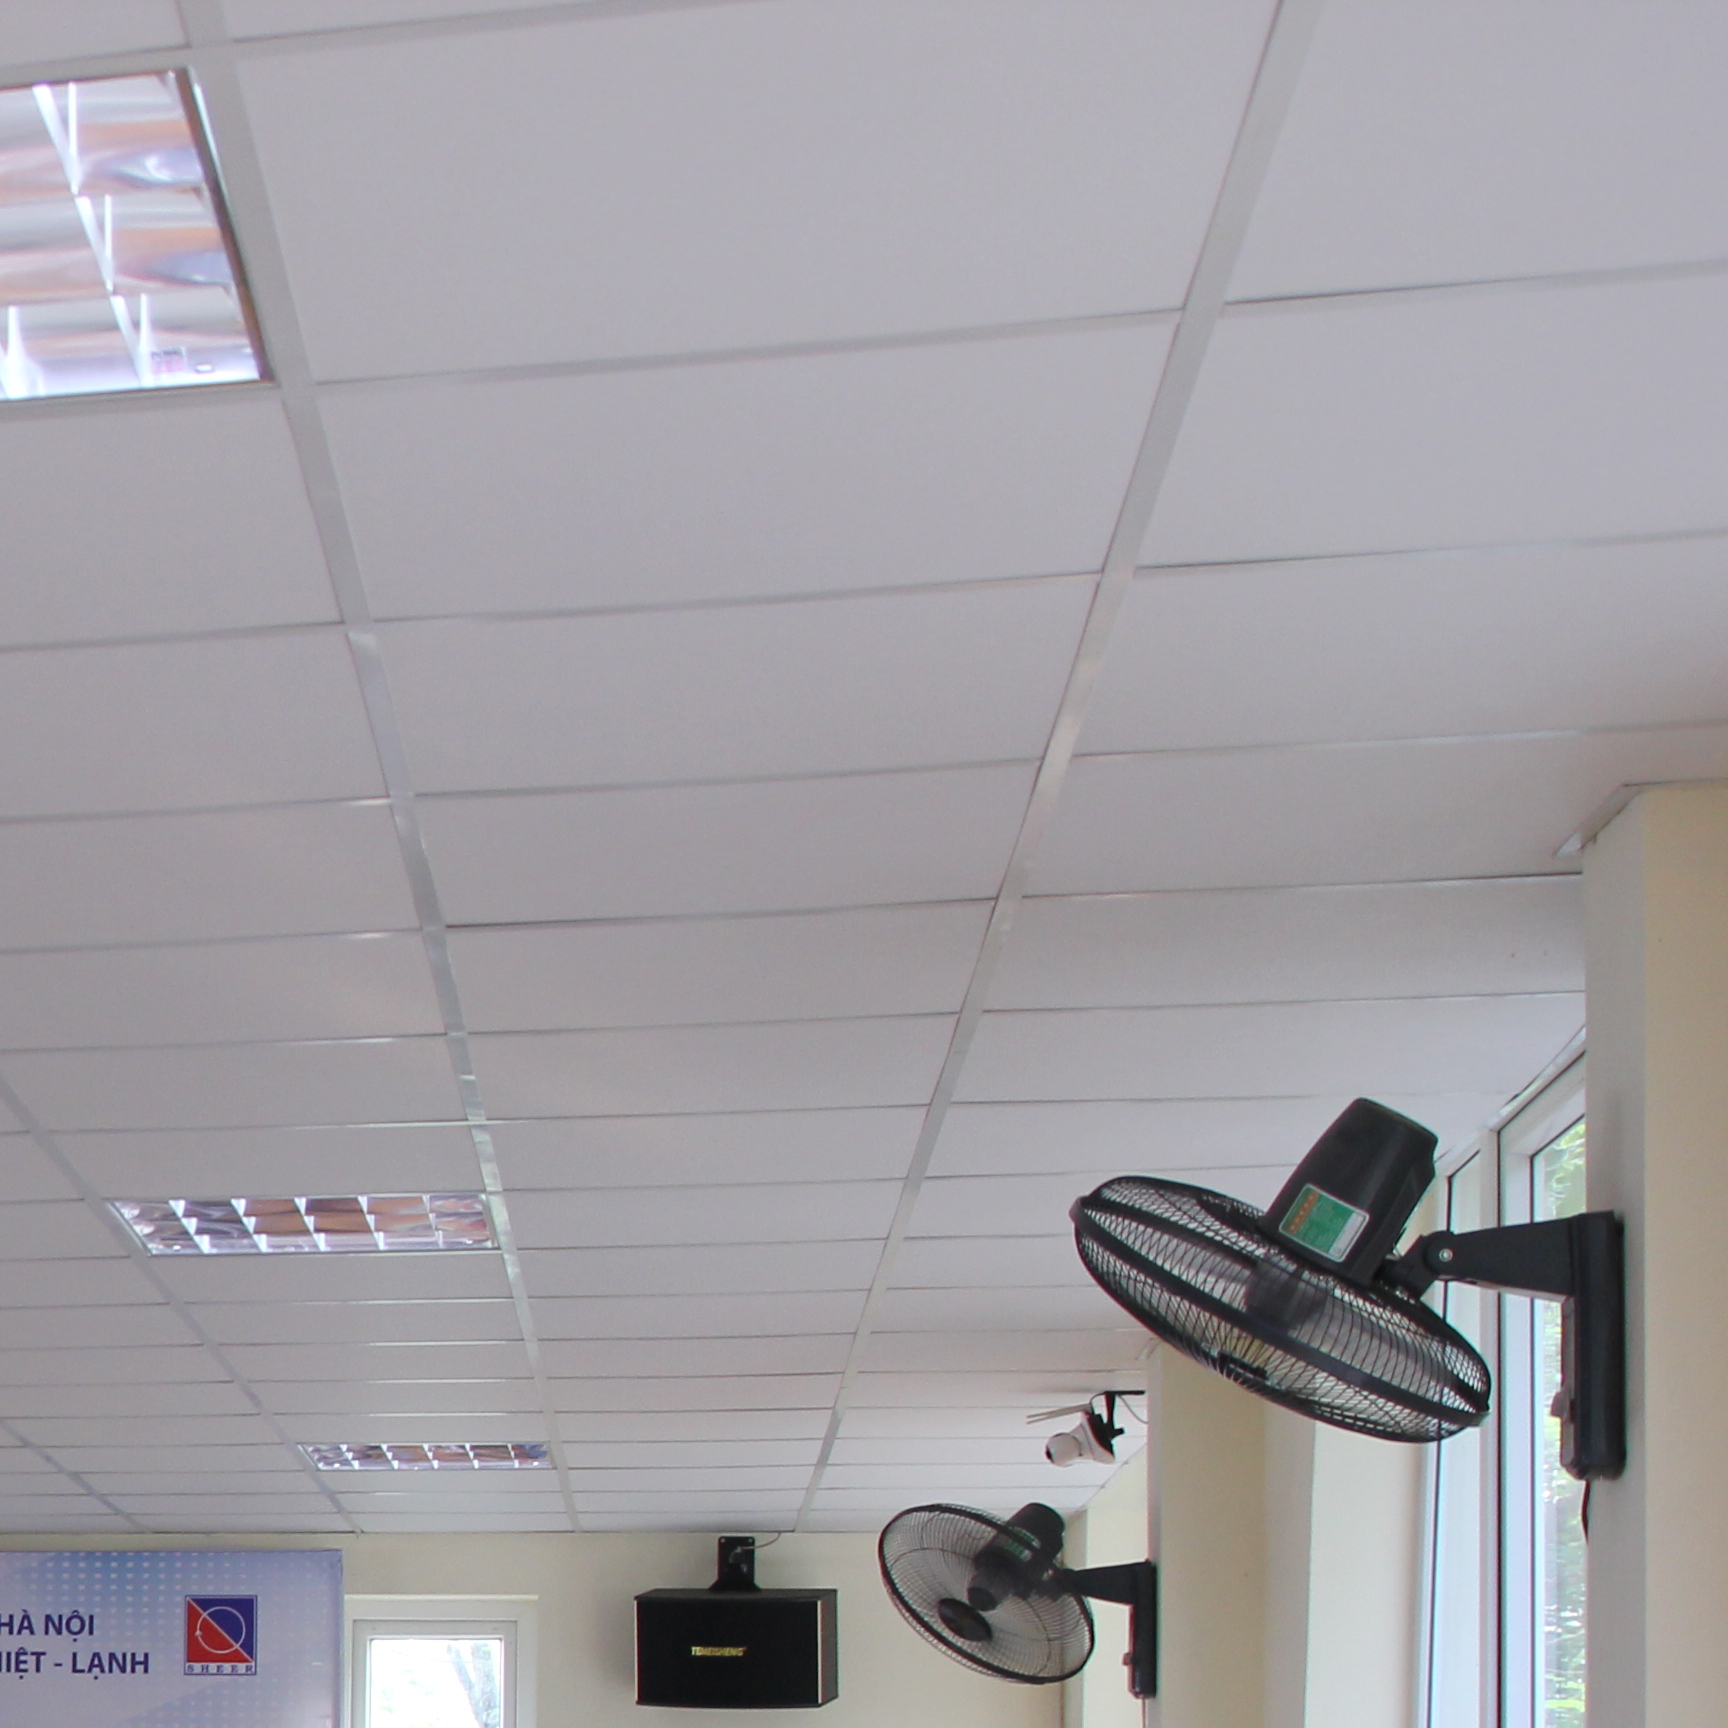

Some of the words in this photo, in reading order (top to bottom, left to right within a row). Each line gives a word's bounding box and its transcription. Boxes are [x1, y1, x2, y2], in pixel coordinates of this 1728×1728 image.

[44, 1609, 95, 1643] NỘI
[70, 1651, 150, 1681] LẠNH
[186, 1663, 256, 1675] SHEER
